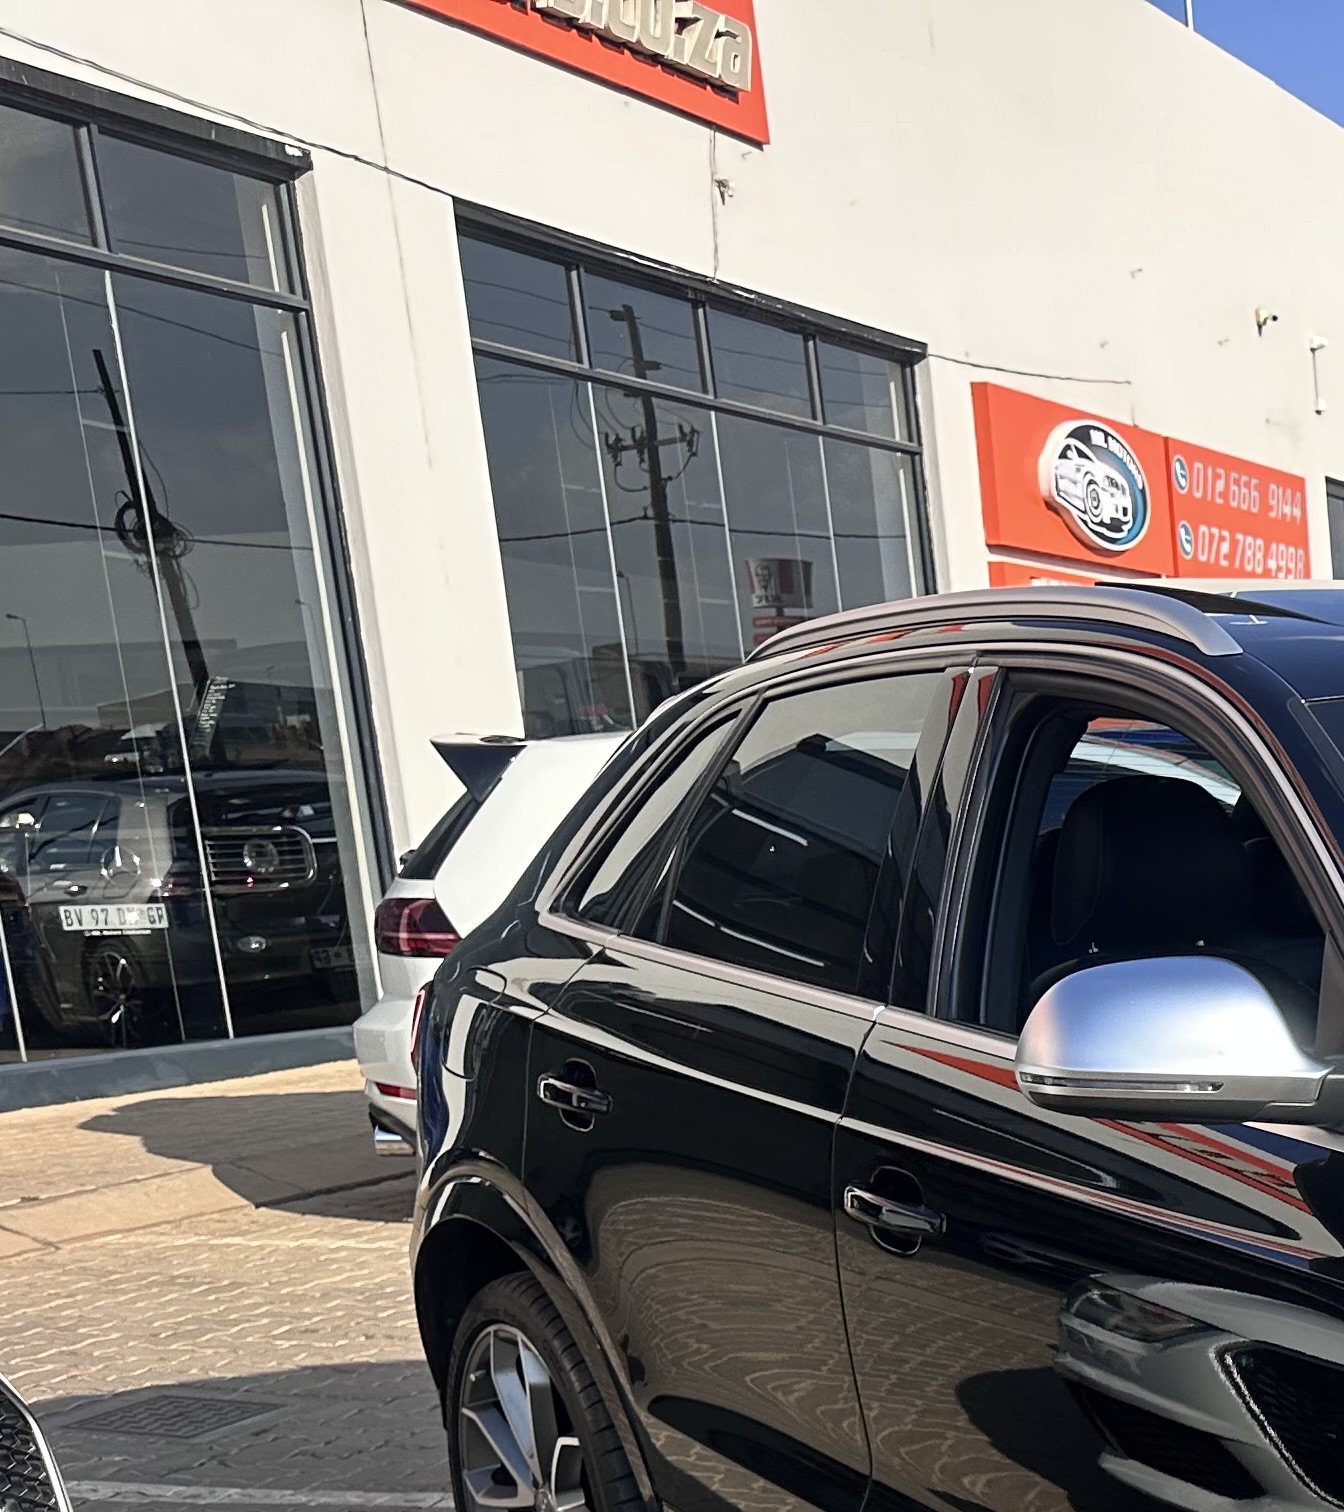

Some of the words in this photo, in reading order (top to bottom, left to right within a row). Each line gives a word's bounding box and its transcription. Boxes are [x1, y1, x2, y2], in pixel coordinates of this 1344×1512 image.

[1193, 460, 1226, 505] 012
[1229, 471, 1260, 514] 666
[1267, 482, 1303, 525] 9144
[1198, 524, 1231, 568] 072
[1234, 532, 1265, 575] 788
[63, 908, 83, 928] BV
[90, 907, 109, 927] 97
